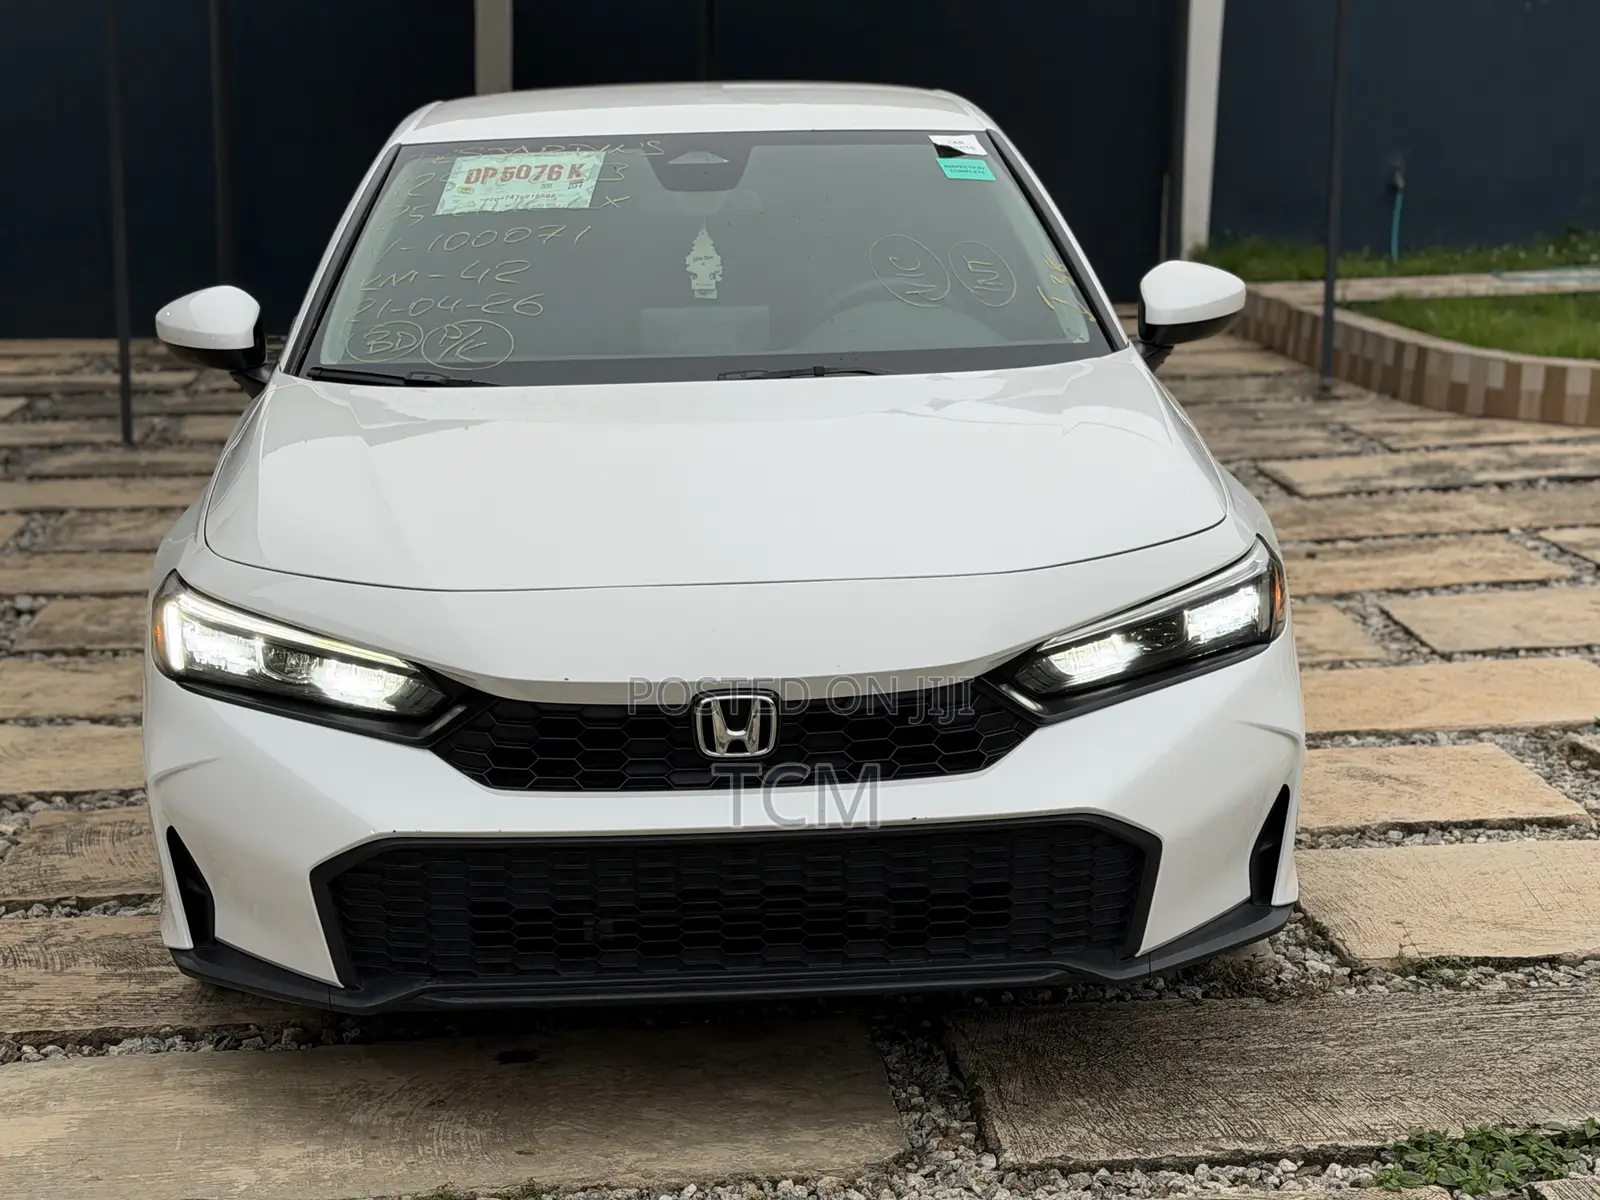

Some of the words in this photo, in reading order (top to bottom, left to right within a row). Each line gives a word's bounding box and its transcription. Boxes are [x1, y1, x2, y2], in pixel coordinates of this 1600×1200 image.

[463, 166, 500, 185] DP
[500, 163, 565, 183] 5076
[566, 163, 586, 181] K
